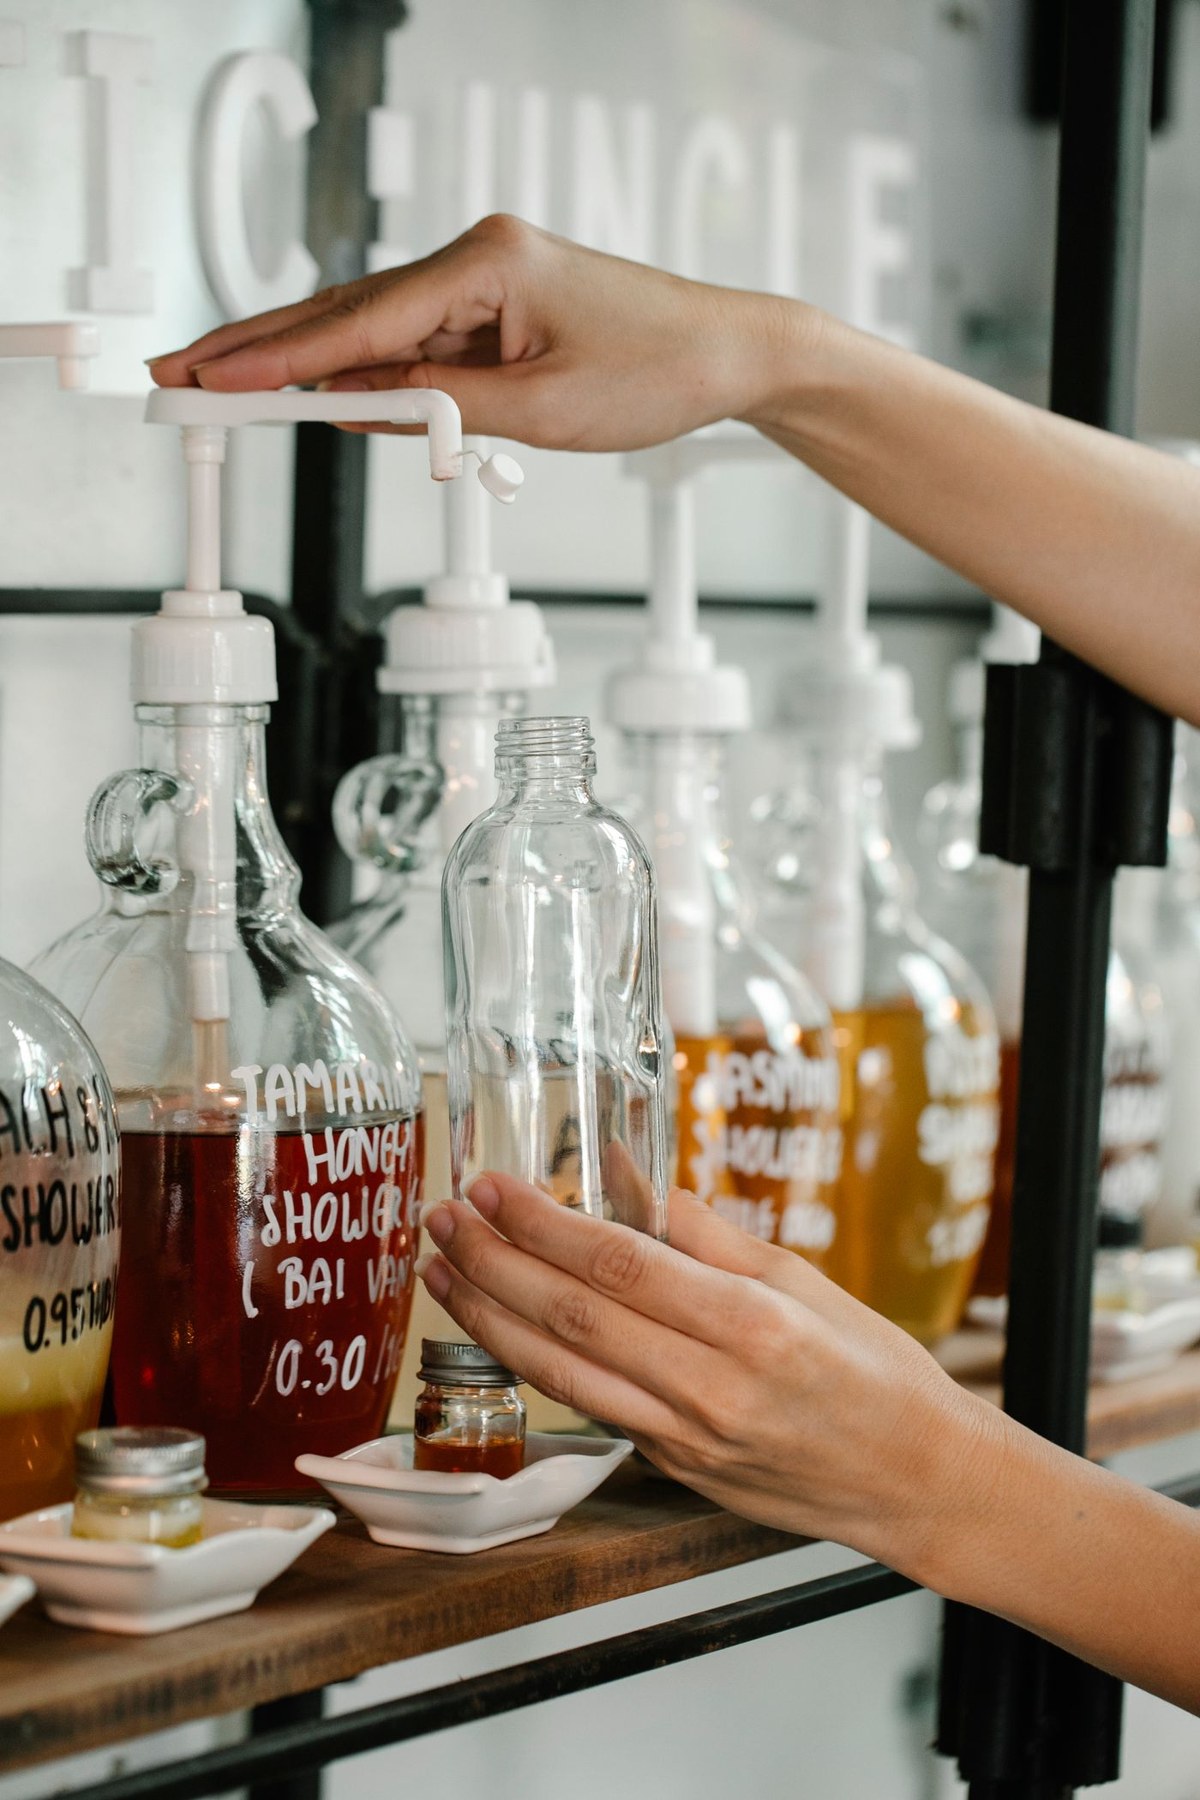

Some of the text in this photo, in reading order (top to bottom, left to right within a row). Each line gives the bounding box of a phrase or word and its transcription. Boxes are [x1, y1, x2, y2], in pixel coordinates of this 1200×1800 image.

[0, 22, 320, 325] IC
[303, 1121, 411, 1186] HONEY
[0, 1174, 116, 1254] SHOWER
[260, 1182, 402, 1248] SHOWER
[276, 1256, 345, 1310] BAI
